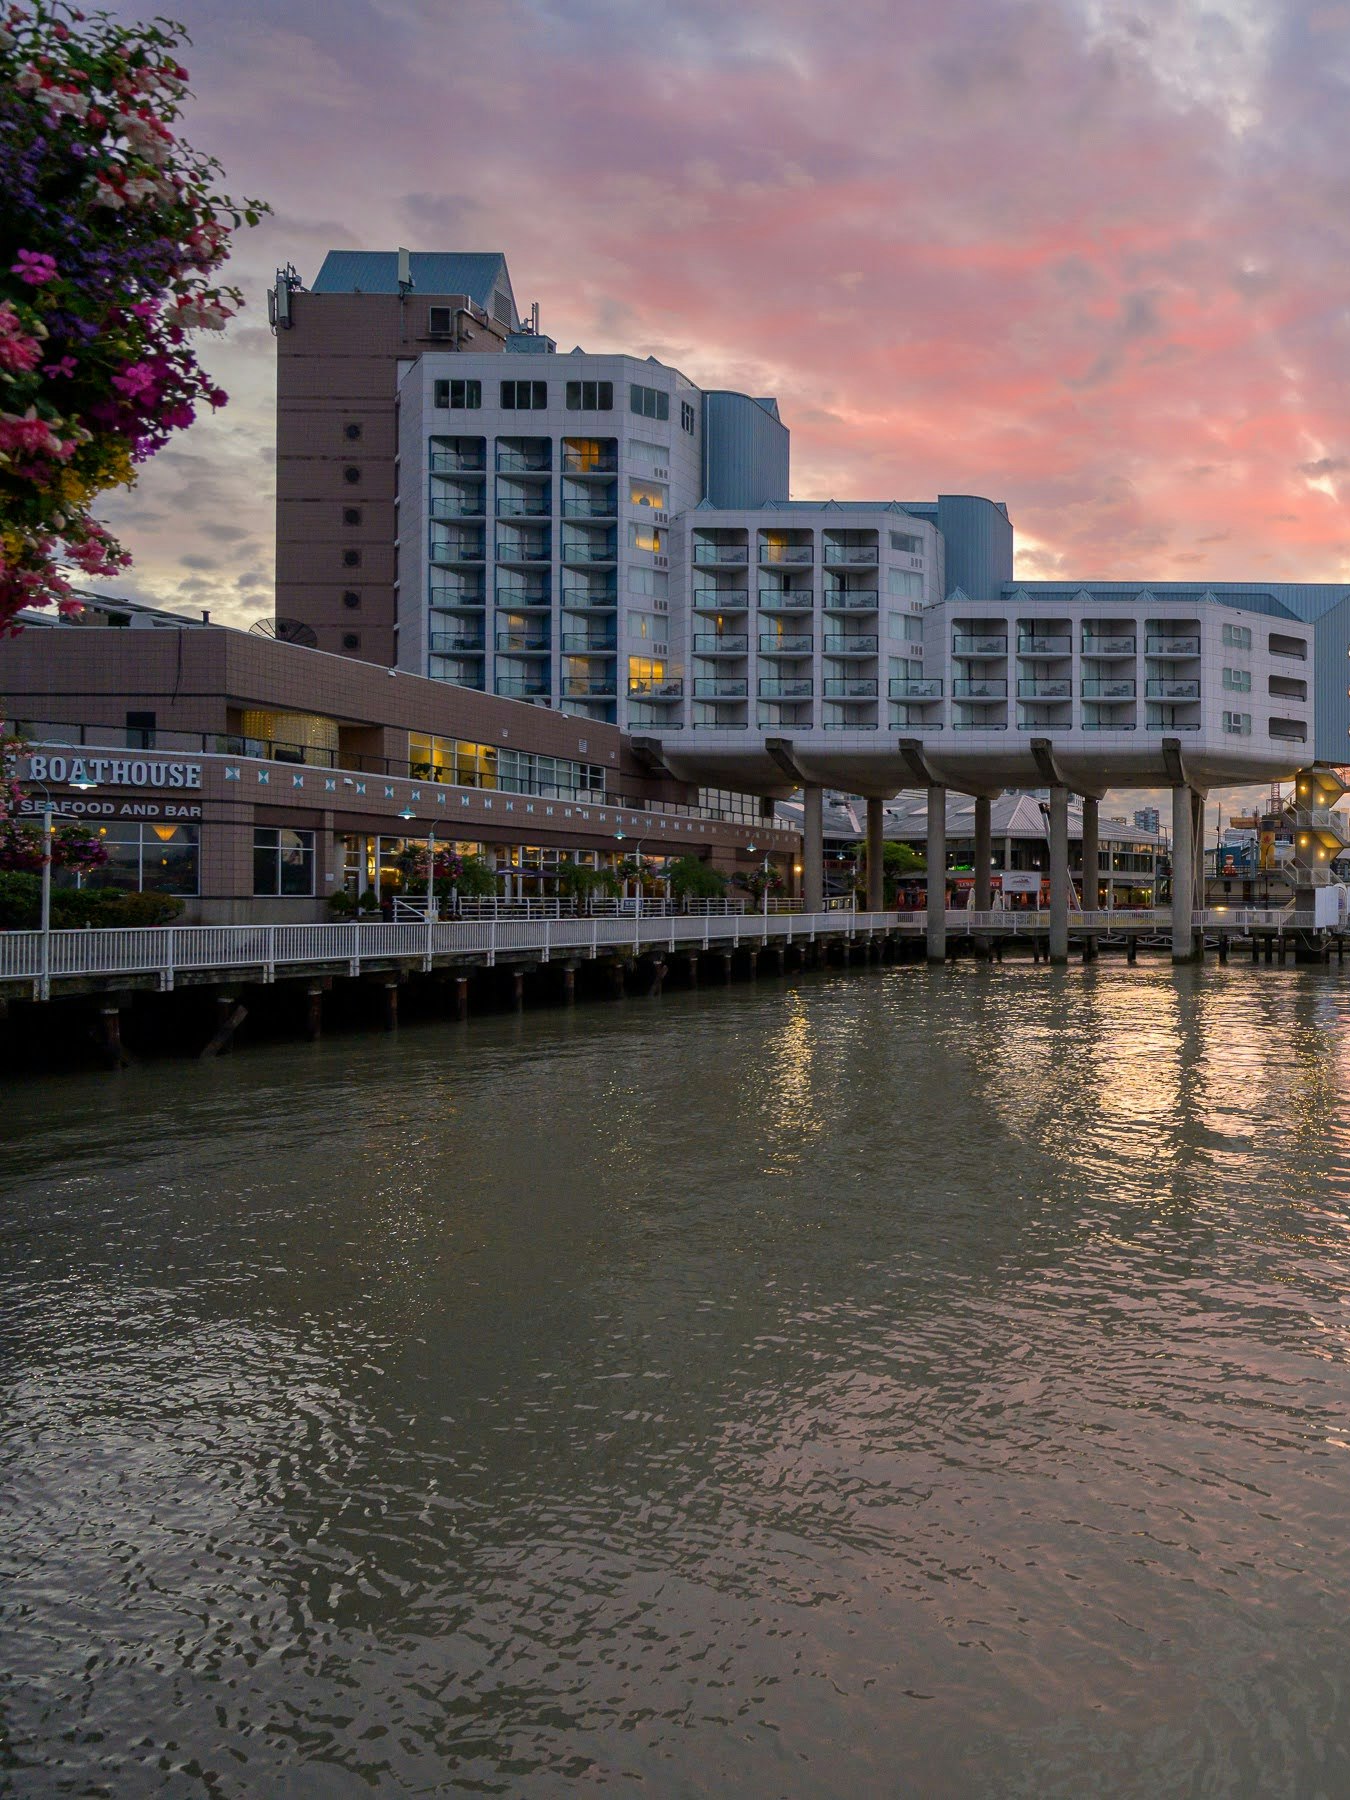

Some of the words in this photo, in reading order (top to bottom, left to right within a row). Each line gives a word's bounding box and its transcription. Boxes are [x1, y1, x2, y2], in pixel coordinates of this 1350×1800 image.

[29, 756, 201, 788] BOATHOUSE
[21, 799, 115, 814] SEAFOOD
[120, 803, 159, 815] AND
[164, 805, 201, 817] BAR
